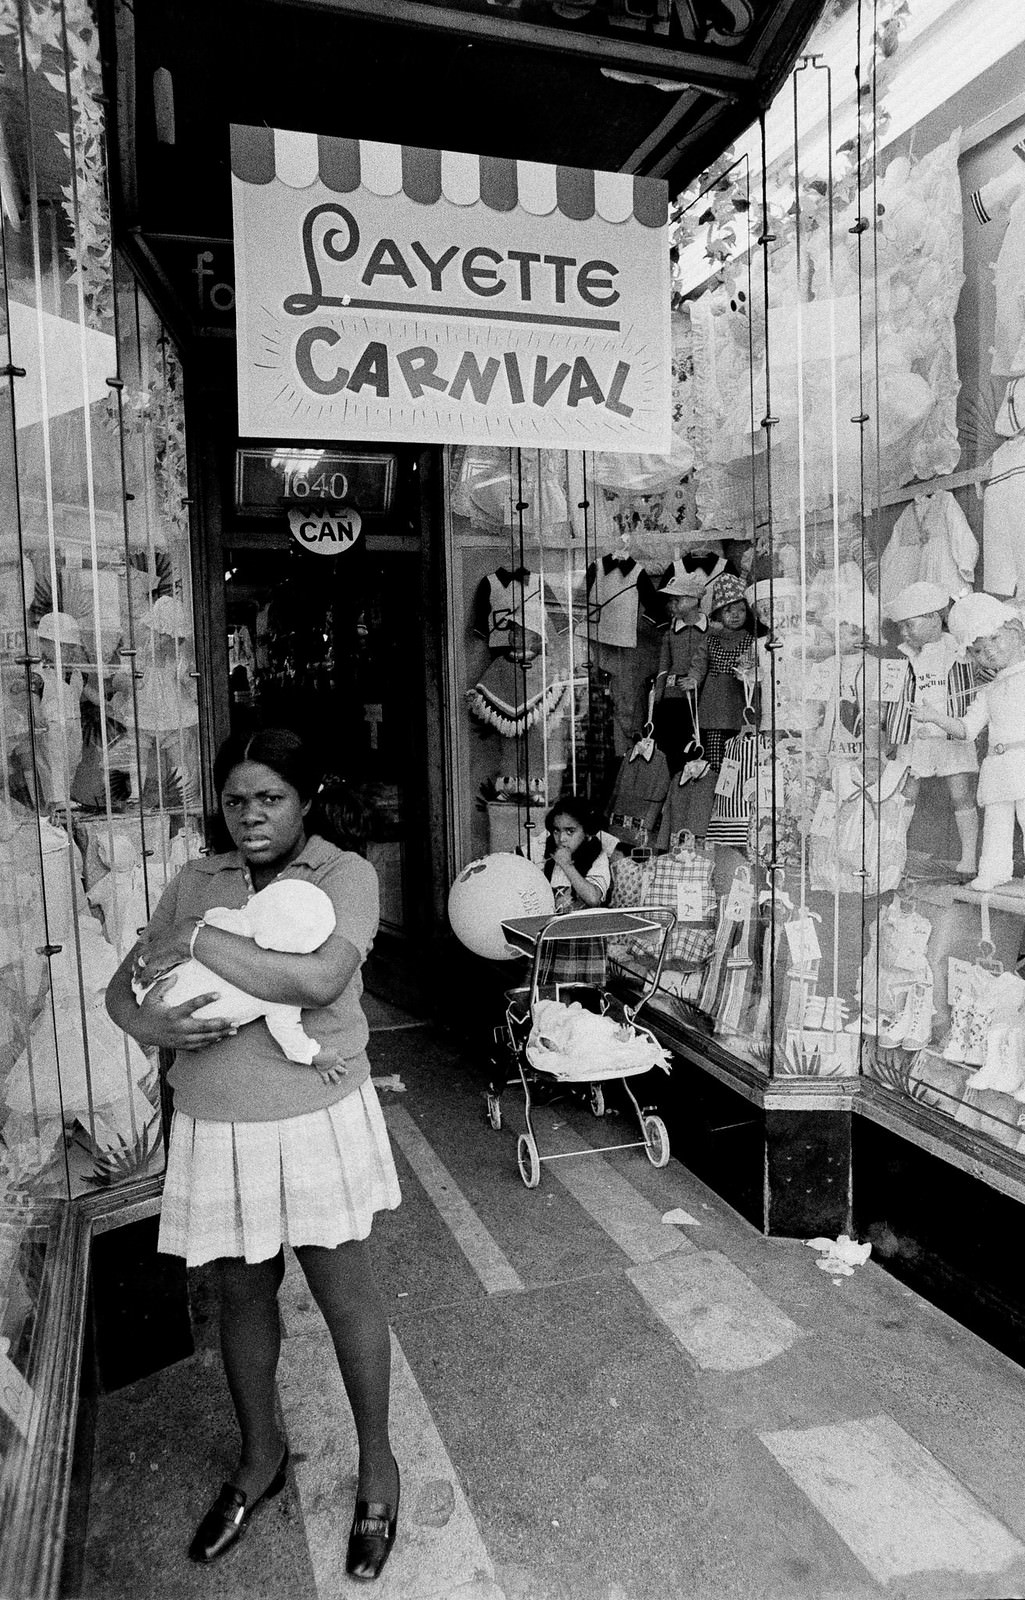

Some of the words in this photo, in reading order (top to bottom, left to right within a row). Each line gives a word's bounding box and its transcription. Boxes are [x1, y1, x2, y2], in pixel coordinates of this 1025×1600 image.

[284, 203, 621, 315] LAYETTE
[295, 325, 636, 419] CARNIVAL
[282, 472, 349, 499] 1640
[300, 521, 355, 542] CAN
